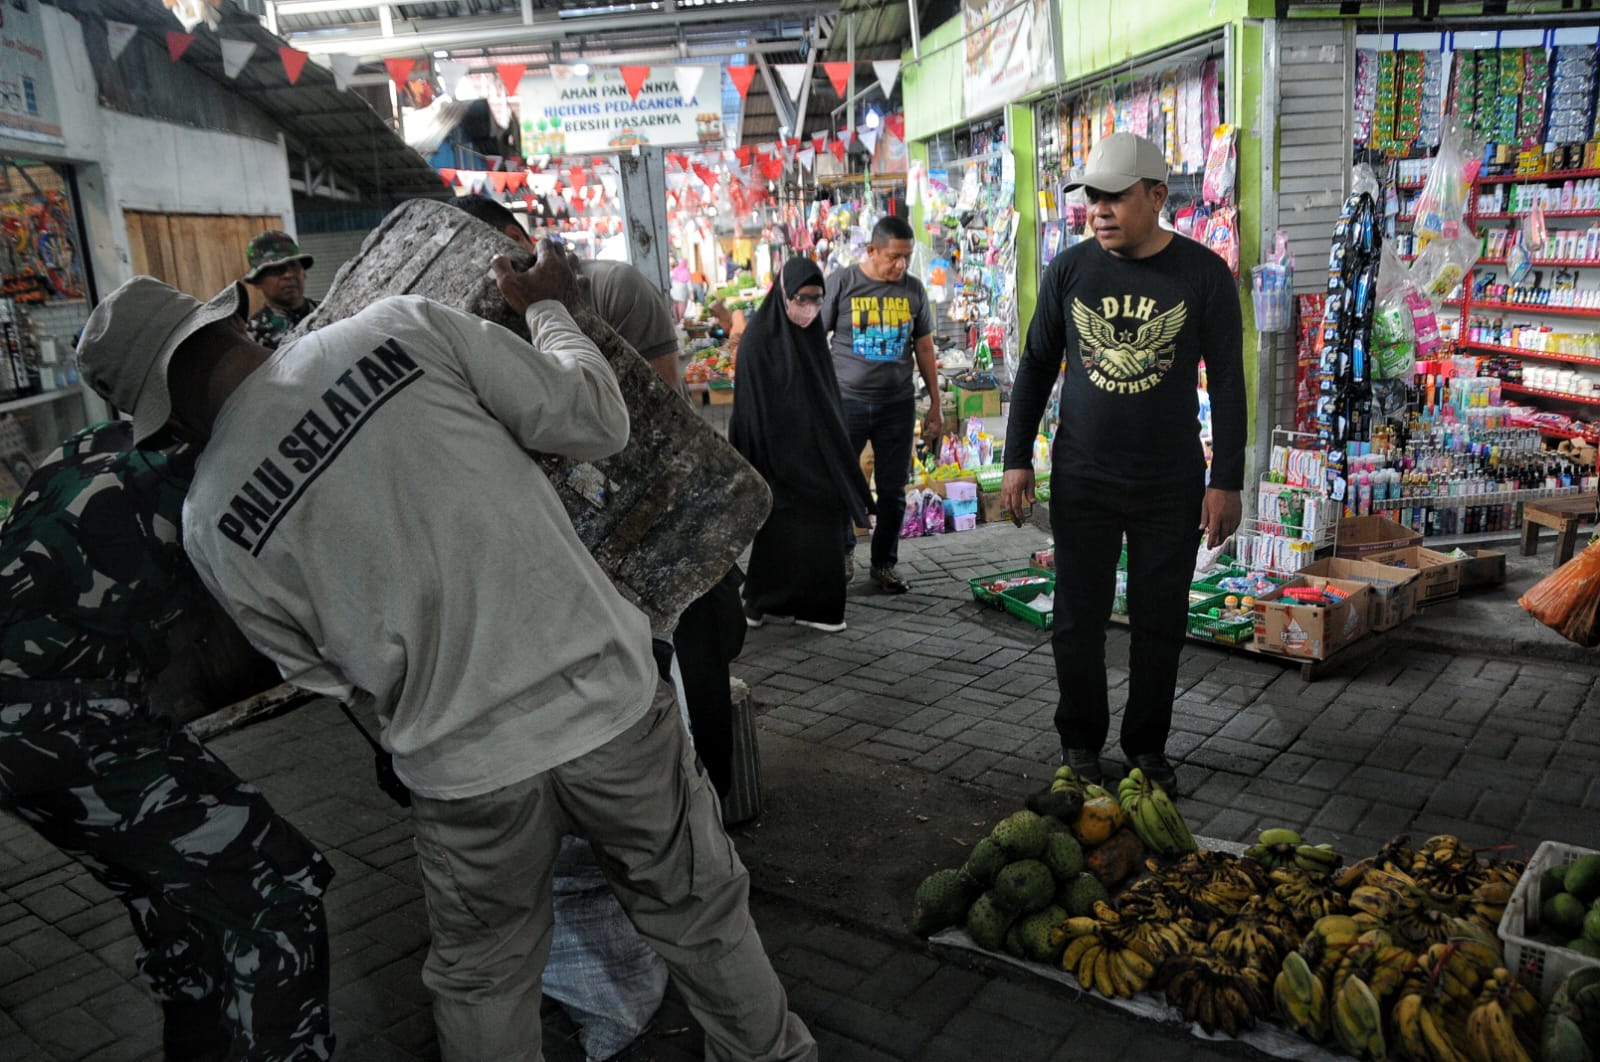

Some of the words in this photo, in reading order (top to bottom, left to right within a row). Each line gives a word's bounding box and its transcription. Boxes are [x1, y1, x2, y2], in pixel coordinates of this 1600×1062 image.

[561, 87, 597, 100] AMAN
[604, 97, 699, 113] PEDAGANGNA
[564, 117, 610, 132] BERSIH
[614, 113, 681, 129] PASARNYA
[851, 296, 880, 311] KITA
[882, 296, 910, 312] JAGA
[1101, 294, 1157, 321] DLH
[1089, 369, 1162, 395] BROTHER
[217, 457, 294, 552] PALU
[278, 338, 418, 474] SELATAN
